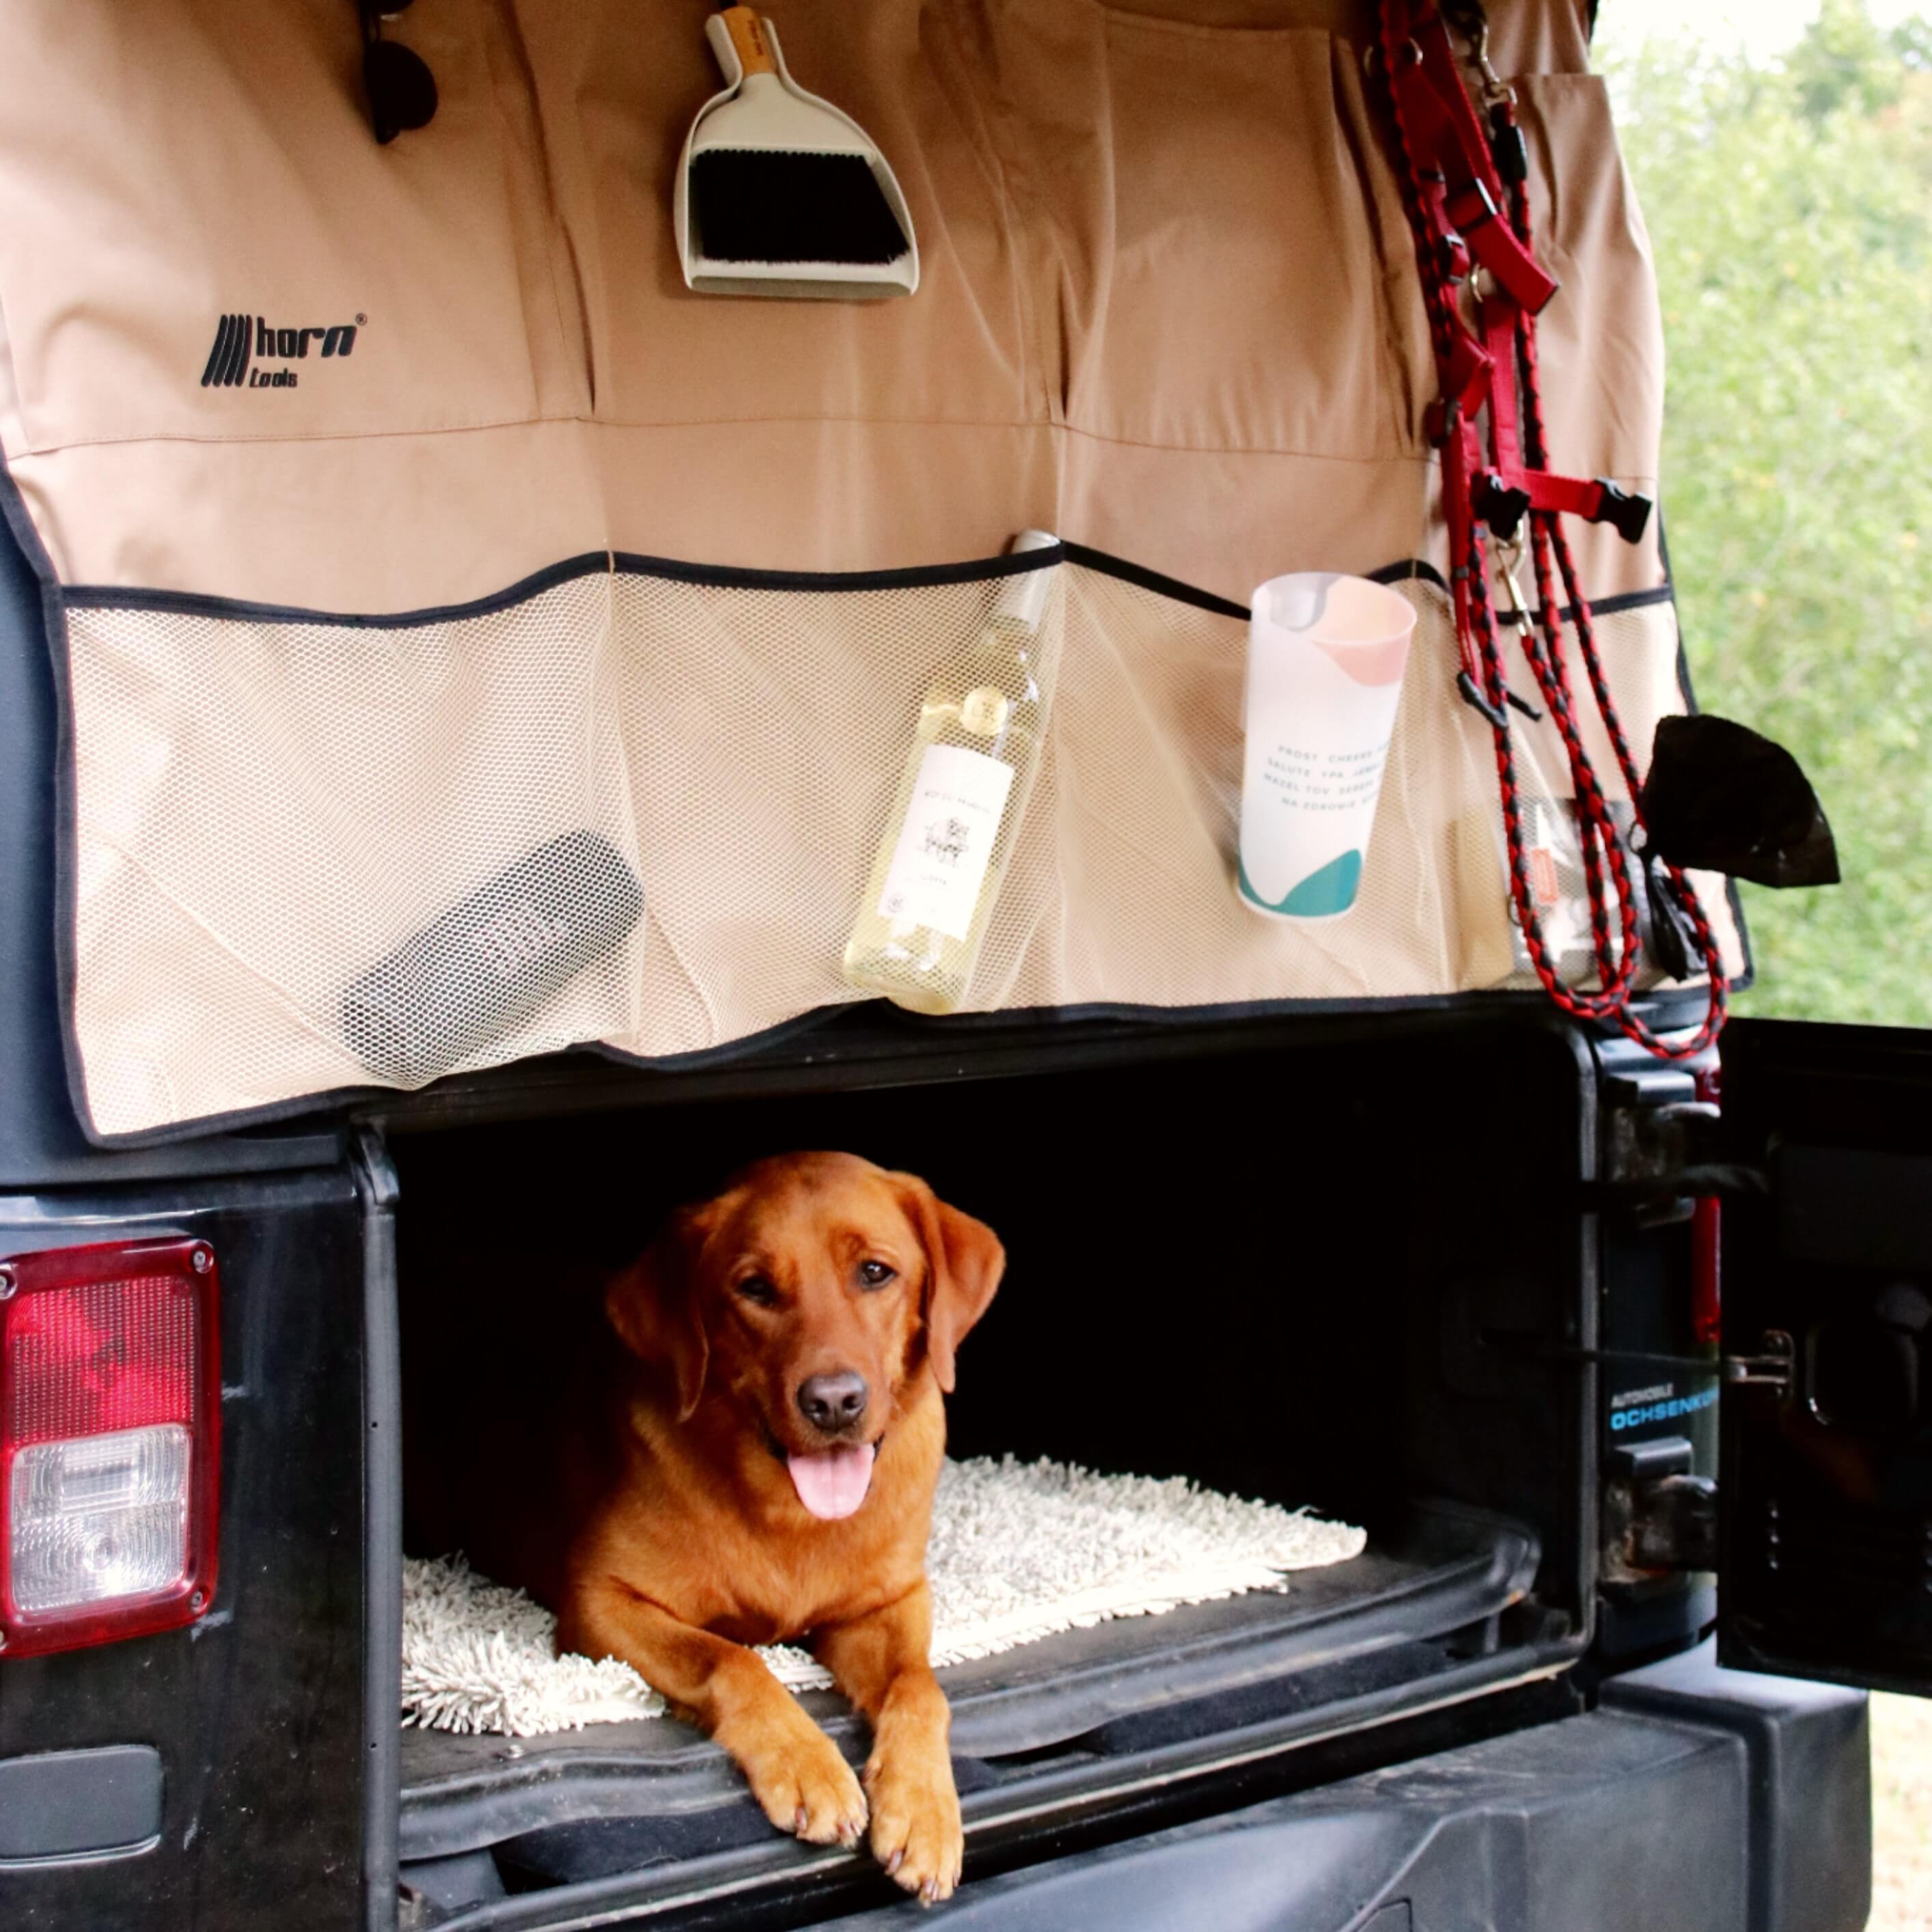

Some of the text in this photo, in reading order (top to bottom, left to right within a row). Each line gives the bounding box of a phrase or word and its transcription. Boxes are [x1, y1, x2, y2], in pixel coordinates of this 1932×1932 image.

[249, 367, 298, 388] tools
[1278, 744, 1319, 761] PROST
[1267, 756, 1310, 777] SALUTE
[1306, 785, 1331, 795] TOV
